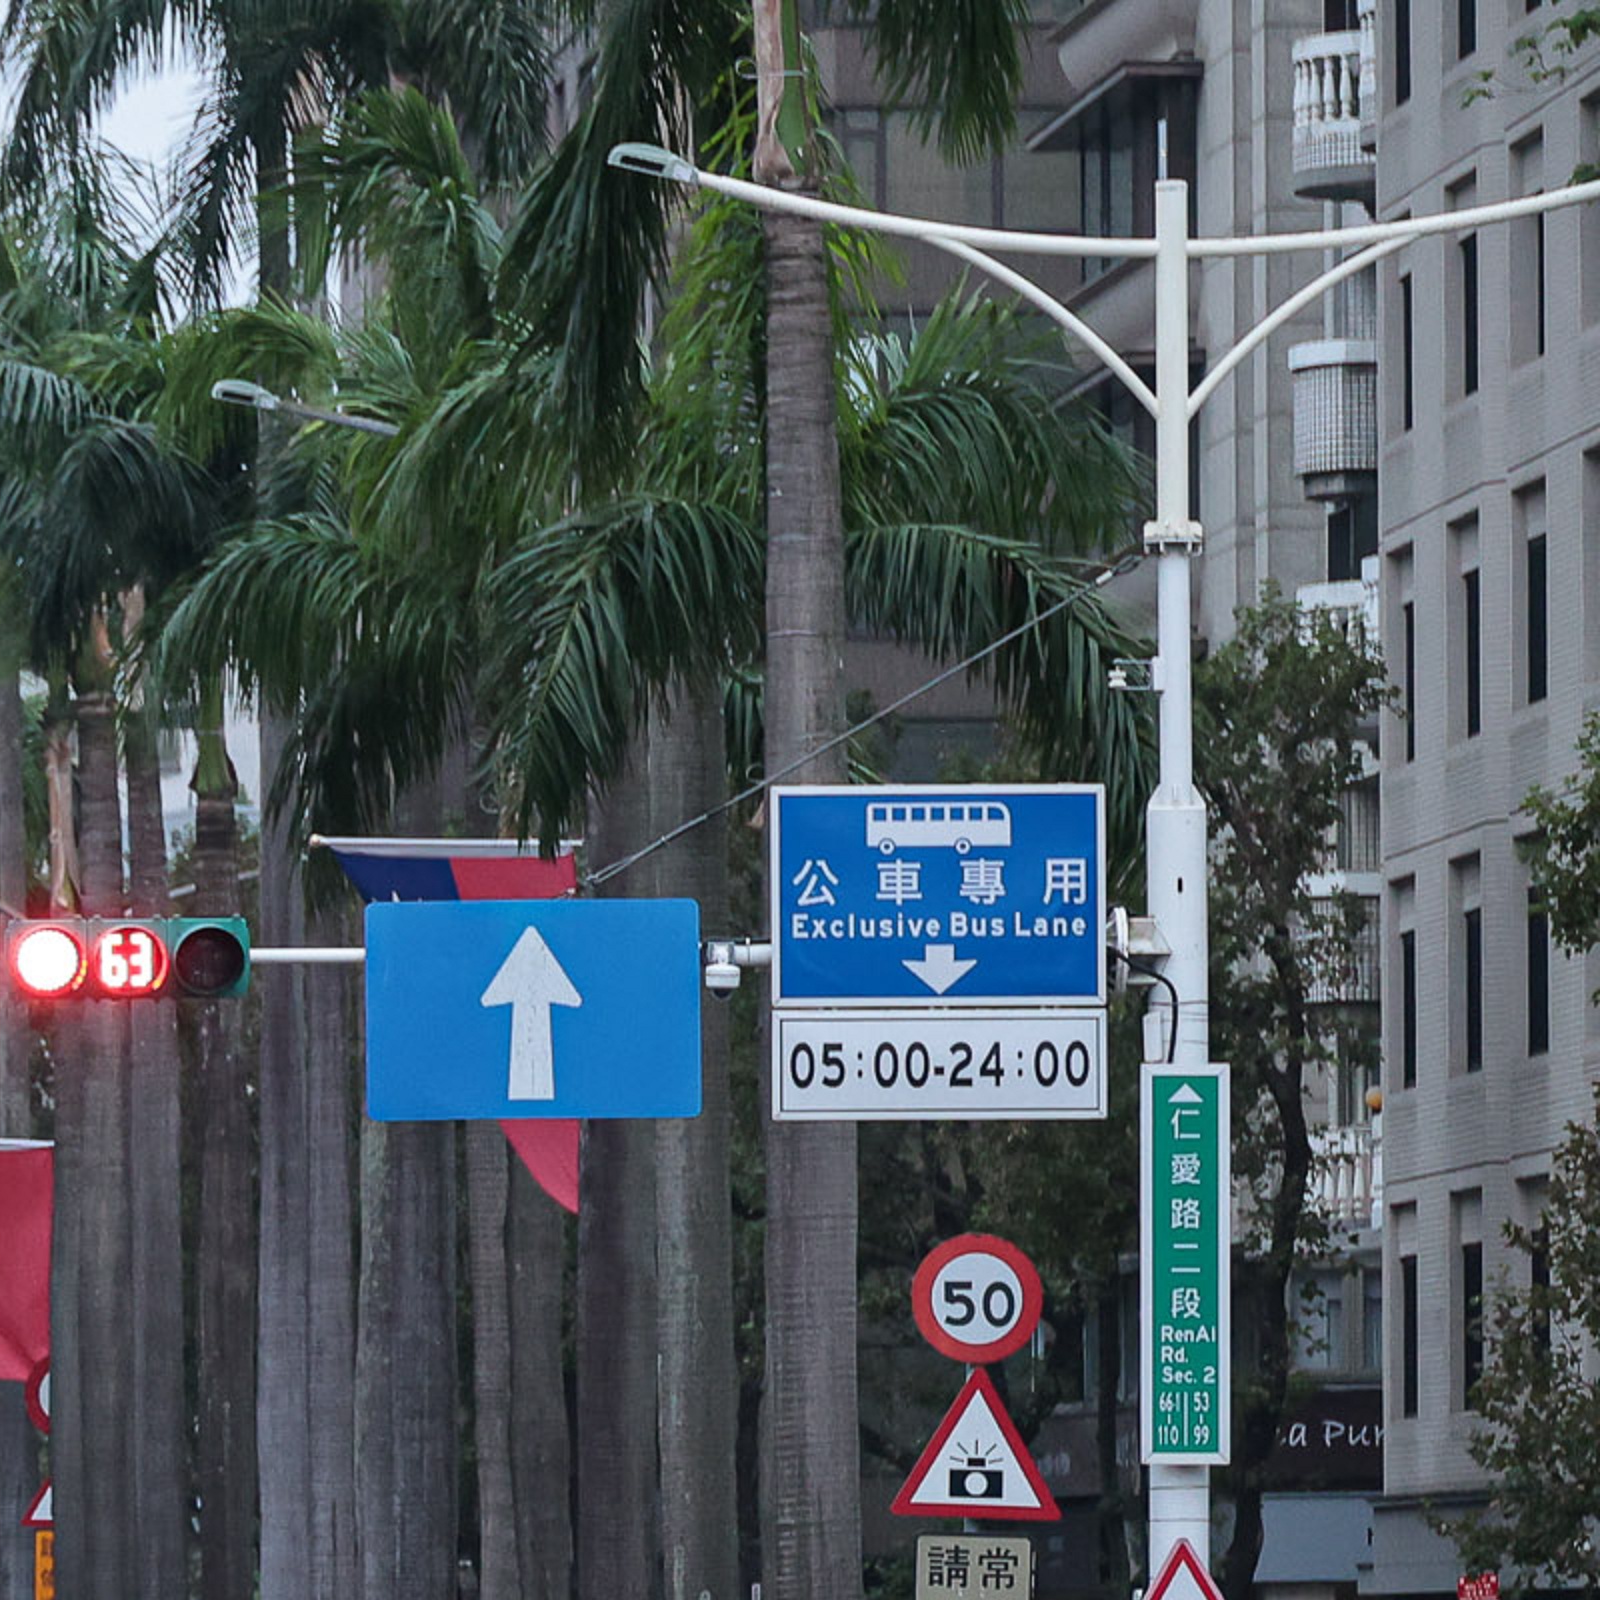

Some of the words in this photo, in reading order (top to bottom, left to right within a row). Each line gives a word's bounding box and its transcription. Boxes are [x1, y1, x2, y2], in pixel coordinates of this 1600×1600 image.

[792, 857, 1088, 906] 公車專用
[791, 913, 941, 939] Exclusive
[950, 912, 1005, 937] Bus
[1014, 911, 1087, 938] Lane
[100, 932, 153, 988] 63
[789, 1040, 1090, 1089] 05:00-24:00
[1171, 1108, 1201, 1319] 仁愛路二段
[943, 1281, 1015, 1328] 50
[1161, 1345, 1189, 1363] Rd.
[1161, 1366, 1197, 1384] Sec.
[1203, 1366, 1216, 1384] 2
[1193, 1391, 1210, 1412] 53
[1158, 1425, 1179, 1446] 110
[1193, 1425, 1210, 1446] 99
